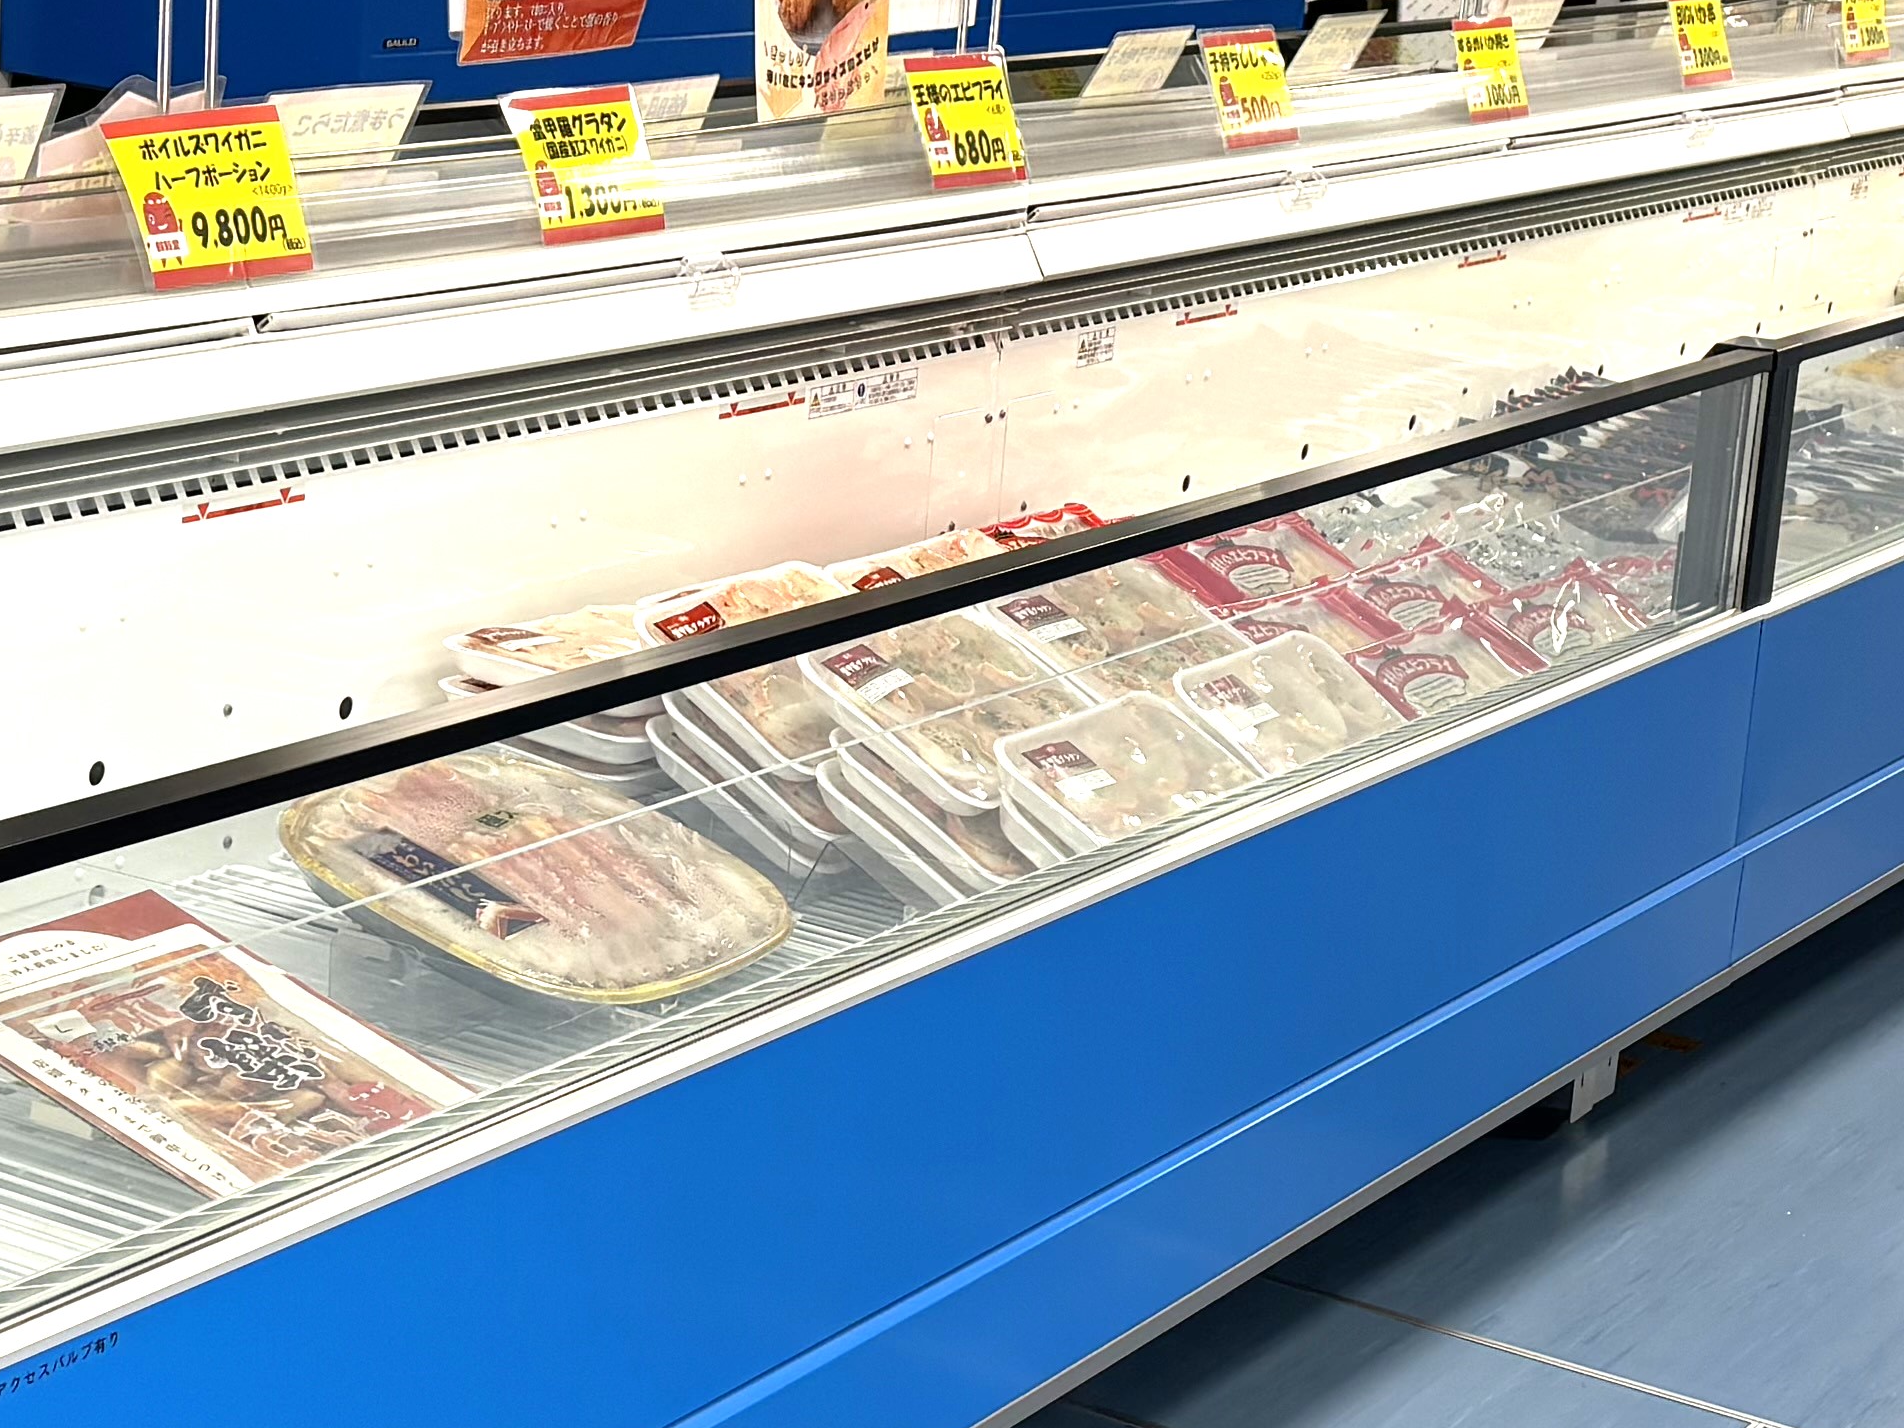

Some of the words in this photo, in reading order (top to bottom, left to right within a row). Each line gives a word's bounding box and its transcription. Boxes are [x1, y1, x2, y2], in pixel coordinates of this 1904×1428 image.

[911, 78, 1005, 108] 王様のエビフライ
[137, 129, 268, 161] ボイルズワイガニ
[954, 128, 1007, 167] 680円
[154, 160, 271, 191] ハーフポーション
[191, 205, 288, 250] 9,800円
